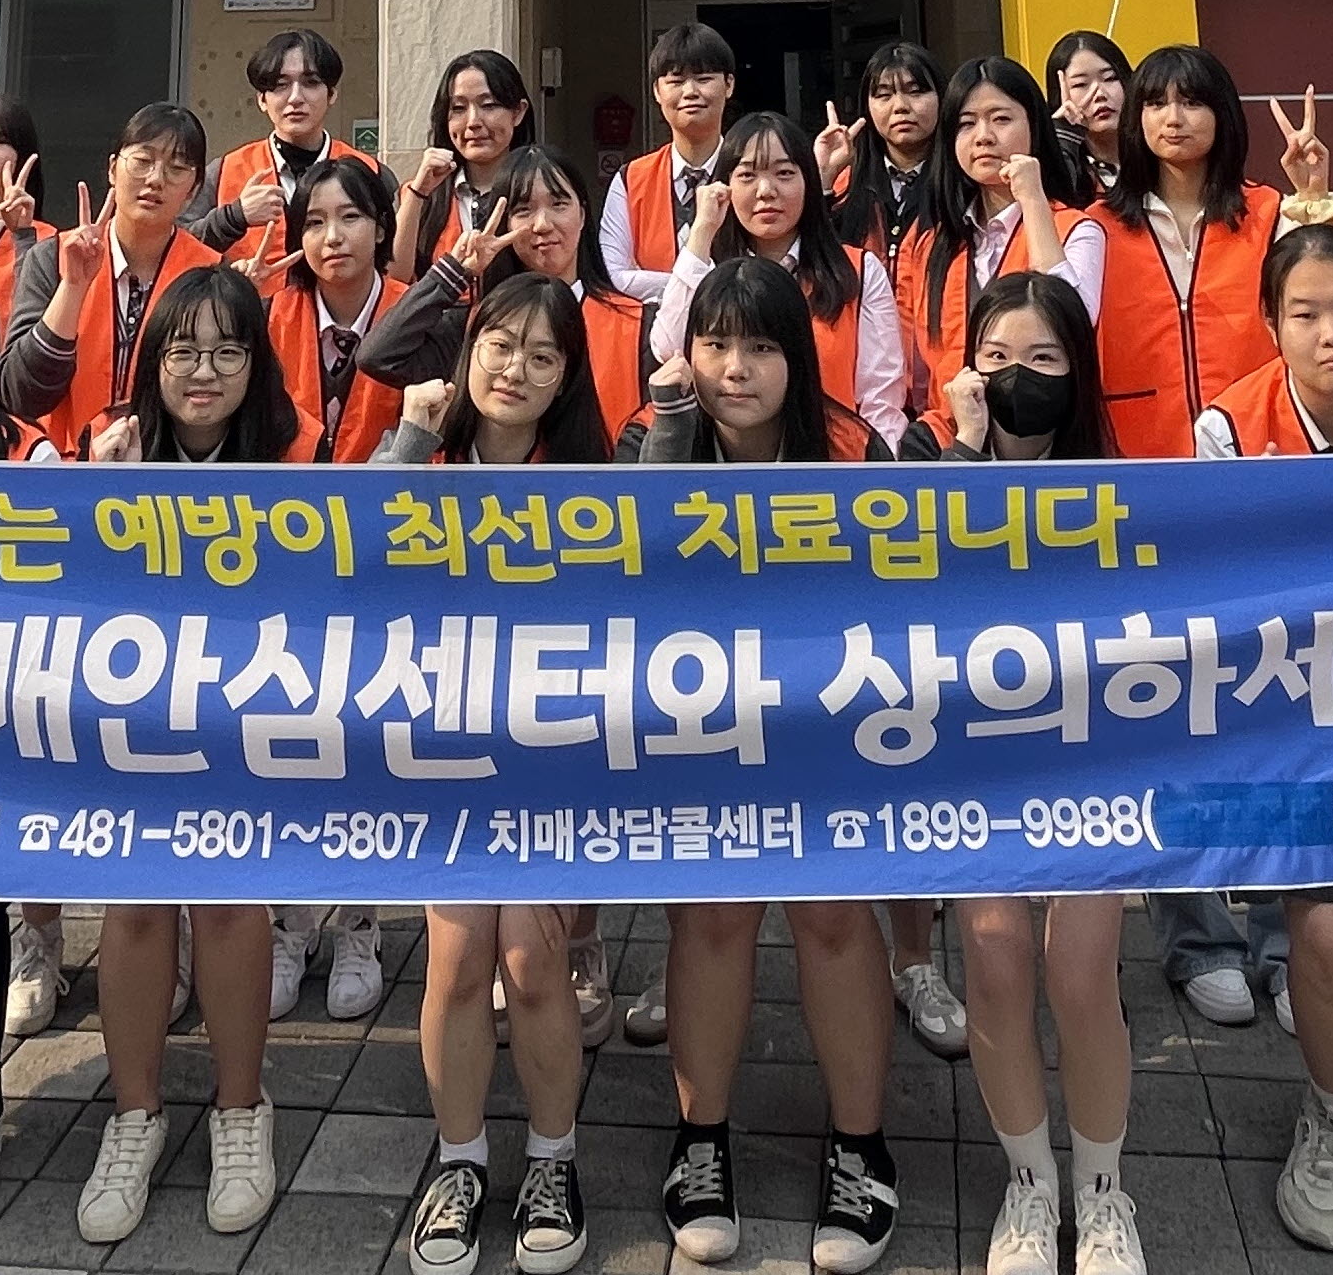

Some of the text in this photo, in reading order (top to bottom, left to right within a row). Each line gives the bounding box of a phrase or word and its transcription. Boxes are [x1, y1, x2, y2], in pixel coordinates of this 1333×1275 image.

[93, 489, 355, 587] 예방이
[385, 486, 641, 584] 최선의
[675, 483, 1157, 581] 치료입니다.
[486, 801, 804, 864] 치매상담콜센터
